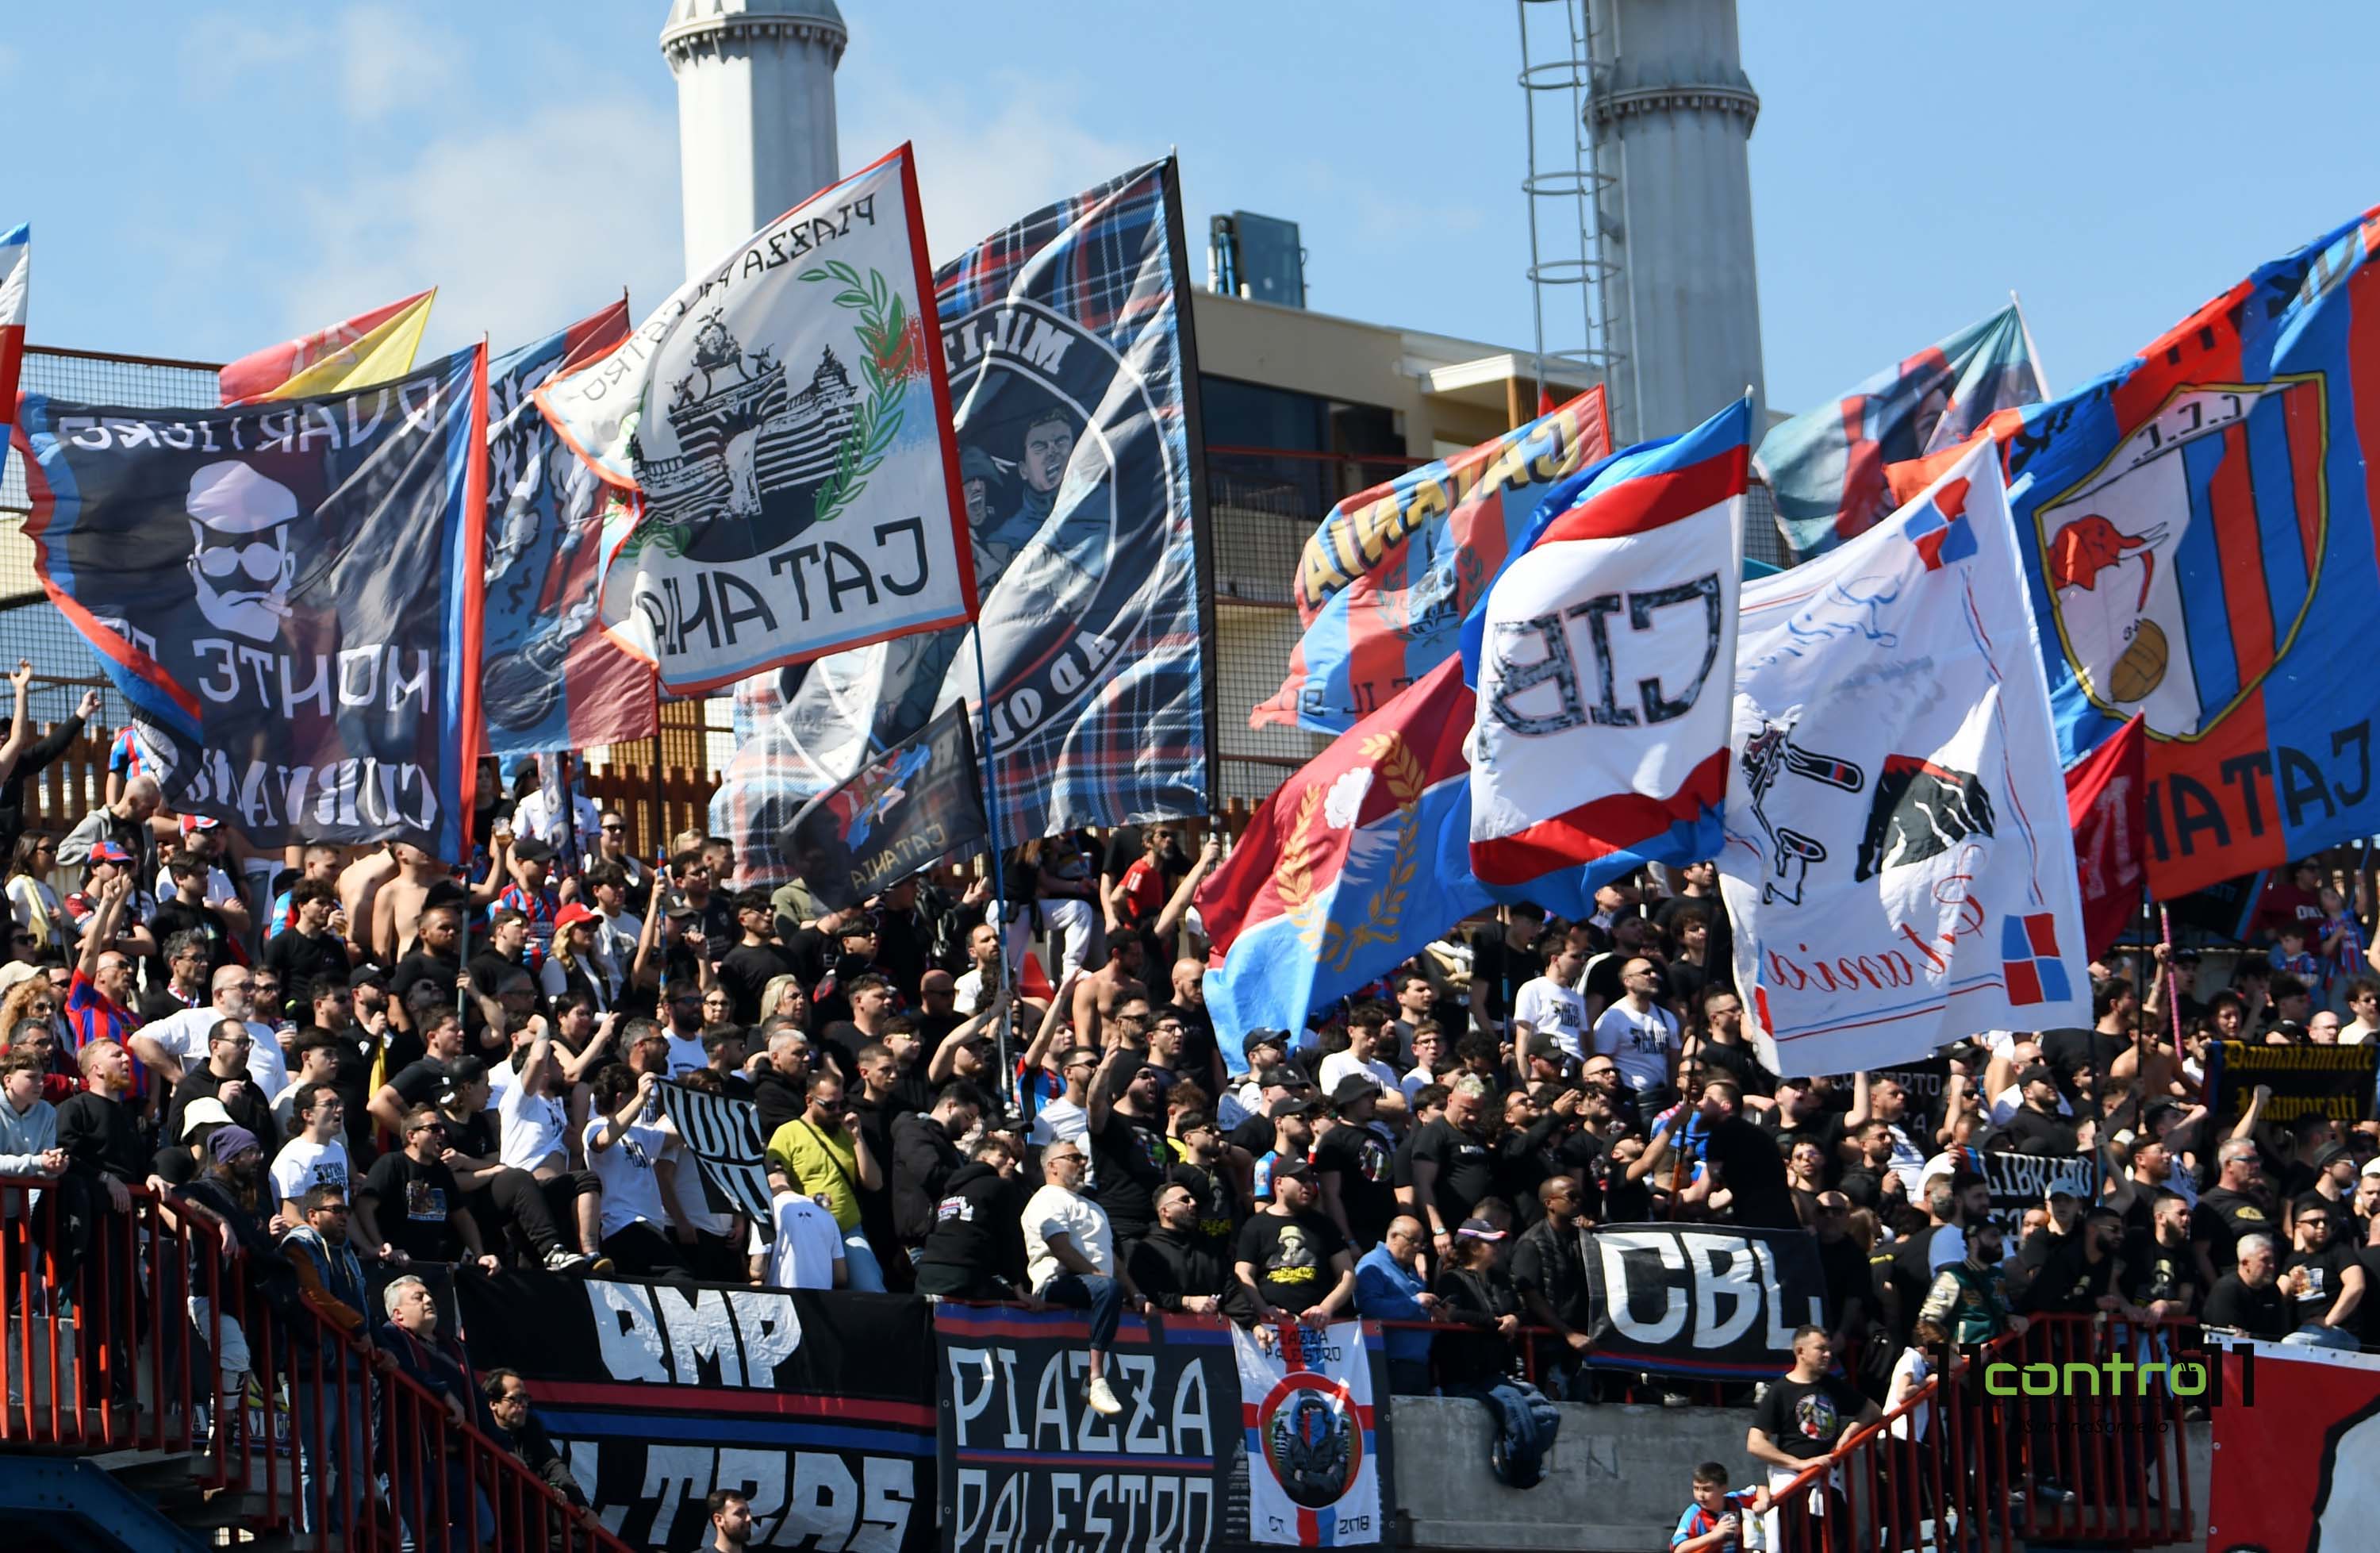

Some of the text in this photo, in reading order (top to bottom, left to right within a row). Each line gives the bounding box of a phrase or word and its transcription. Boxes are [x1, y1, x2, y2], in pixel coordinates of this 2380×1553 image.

[2236, 1084, 2359, 1121] Iamorati
[1593, 1232, 1824, 1350] CBL
[1264, 1346, 1342, 1363] PALESTRO
[1272, 1328, 1329, 1345] PIAZZA
[948, 1346, 1214, 1455] PIAZZA
[547, 1439, 915, 1553] LTRAS
[954, 1467, 1215, 1553] PALESTRO
